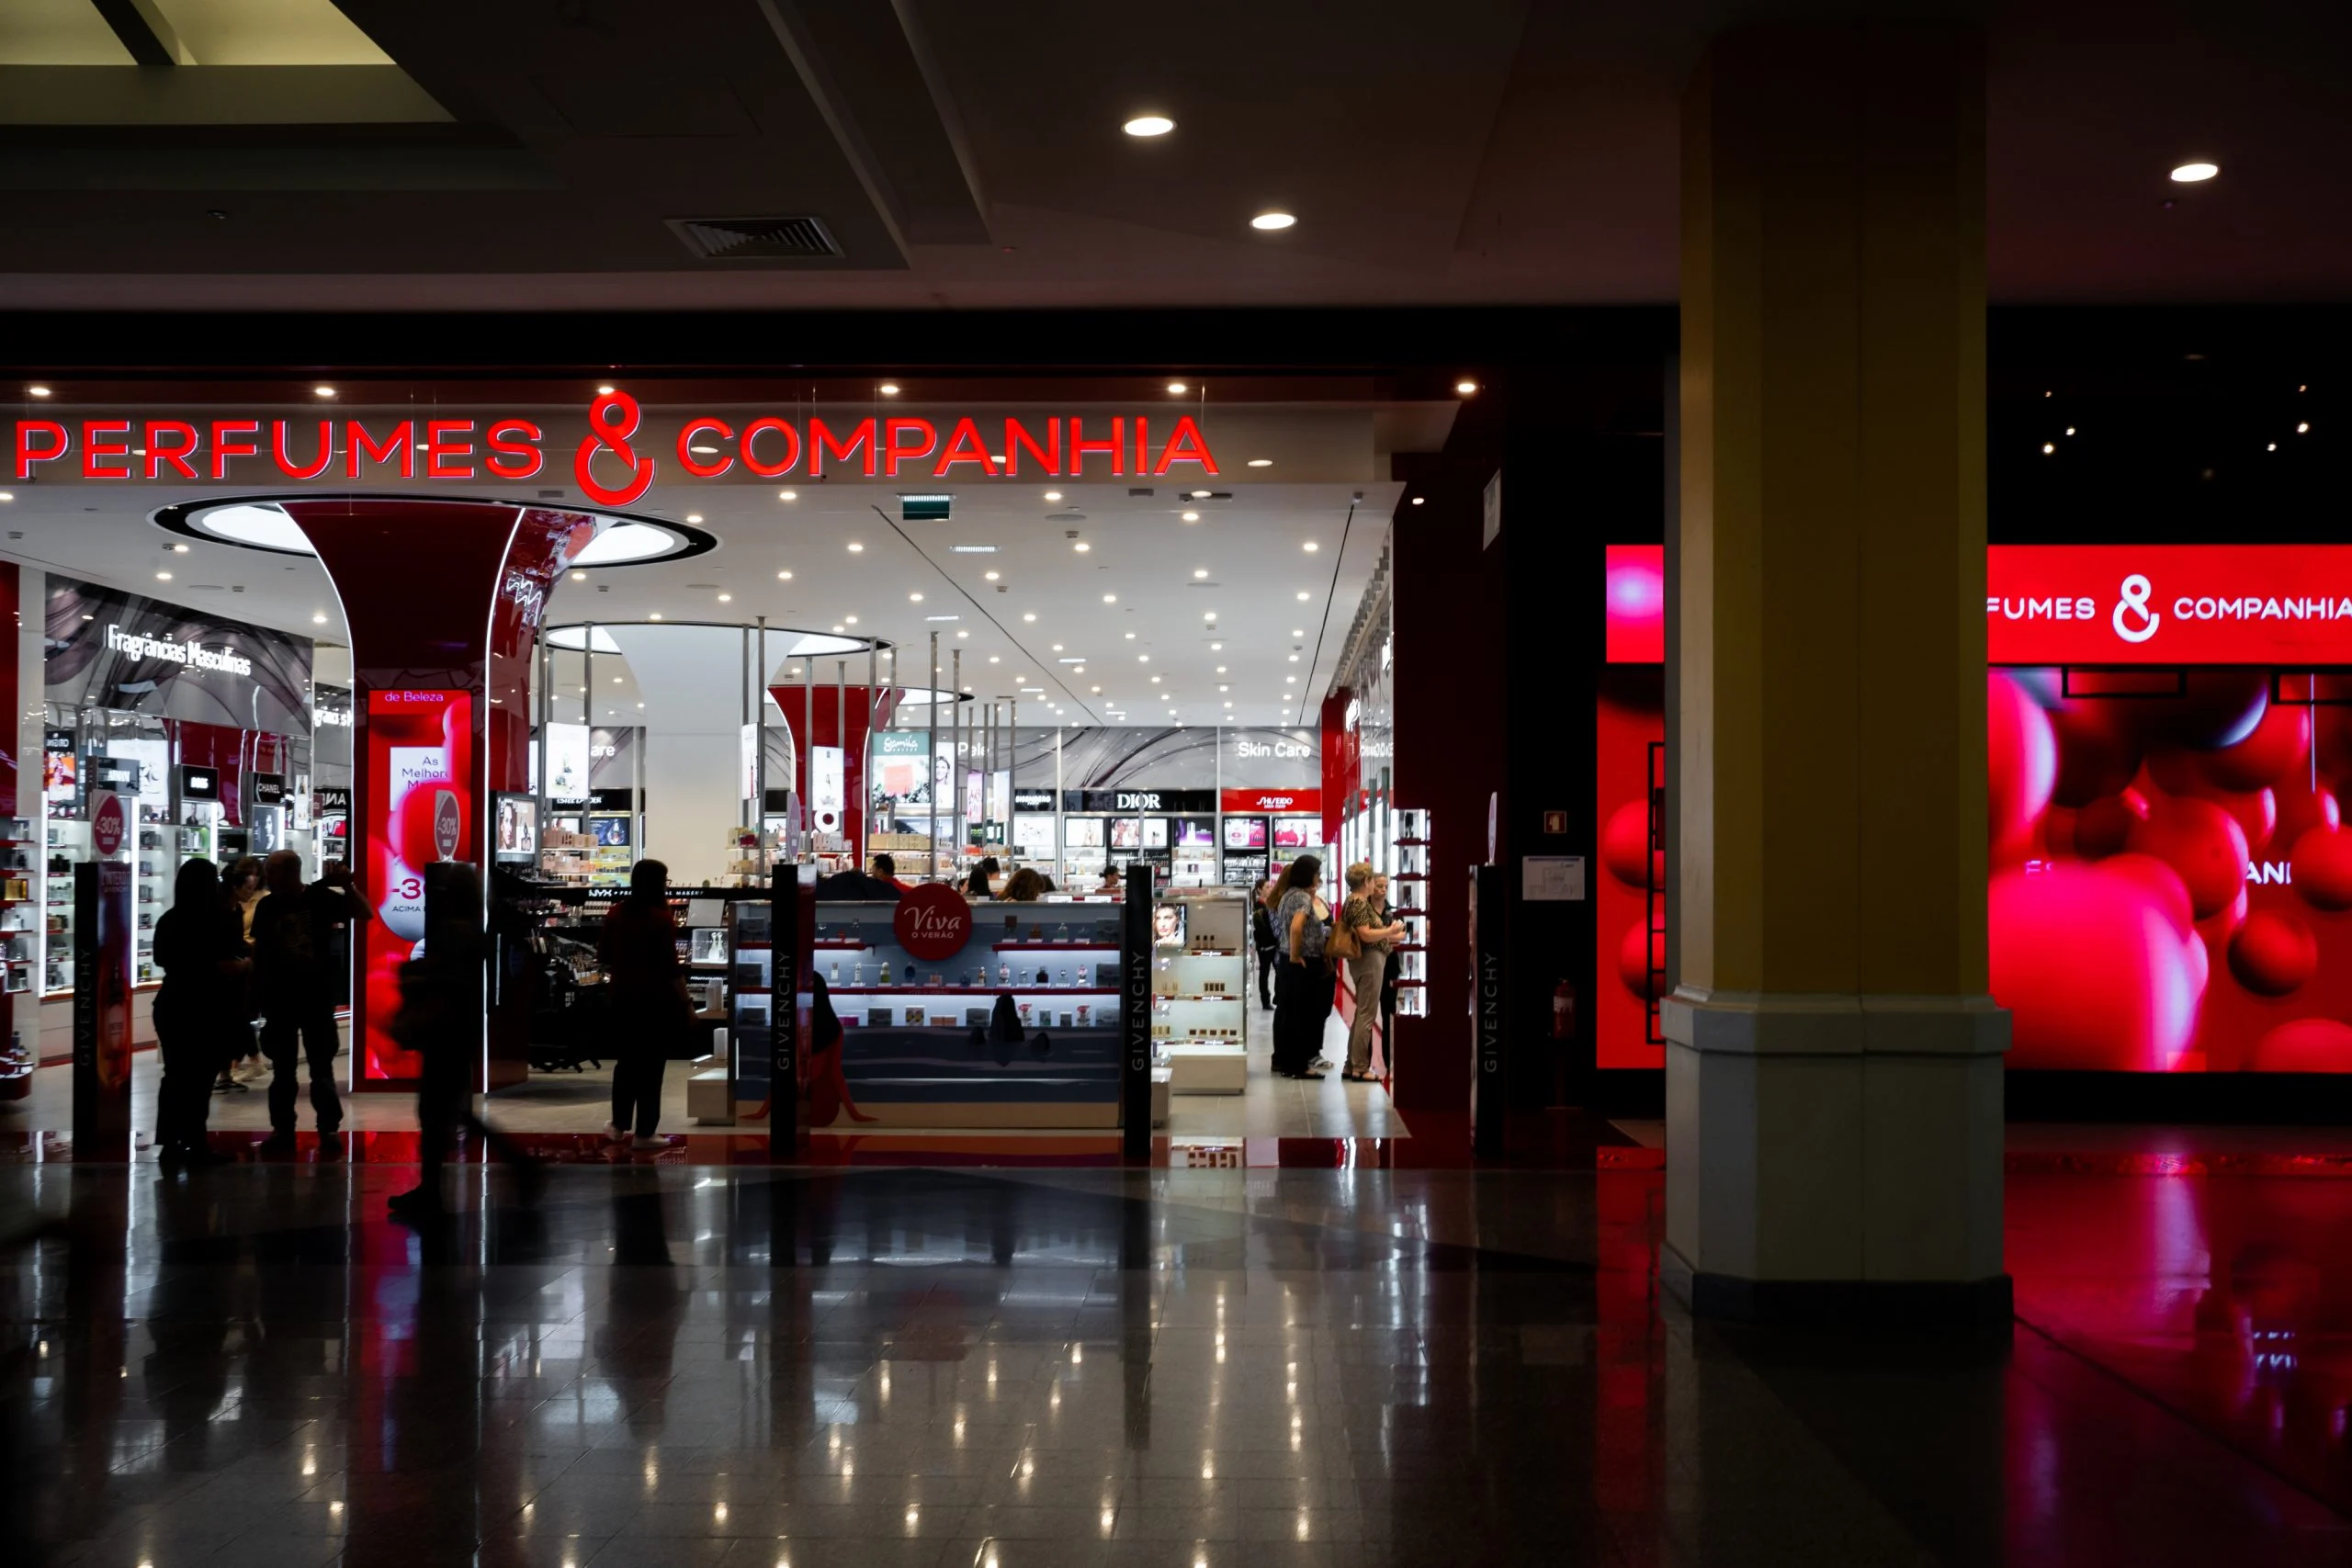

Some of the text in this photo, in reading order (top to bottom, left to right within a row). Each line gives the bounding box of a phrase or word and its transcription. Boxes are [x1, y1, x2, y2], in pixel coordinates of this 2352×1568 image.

[16, 389, 1221, 506] PERFUMES & COMPANHIA
[1987, 574, 2352, 643] FUMES & COMPANHIA
[187, 640, 252, 677] Masculinas
[385, 692, 444, 703] de Beleza
[590, 746, 616, 757] are
[1238, 741, 1311, 758] Skin Care
[423, 756, 439, 766] As
[401, 768, 449, 779] Melhor
[258, 783, 280, 795] CHANEL
[1116, 794, 1161, 809] DIOR
[1256, 796, 1294, 806] SHISEIDO
[95, 817, 120, 835] -30%
[438, 817, 457, 836] -30%
[903, 905, 962, 931] Viva
[79, 948, 92, 1066] GIVENCHY
[777, 951, 791, 1071] GIVENCHY
[1131, 951, 1146, 1072] GIVENCHY
[1484, 952, 1498, 1073] GIVENCHY
